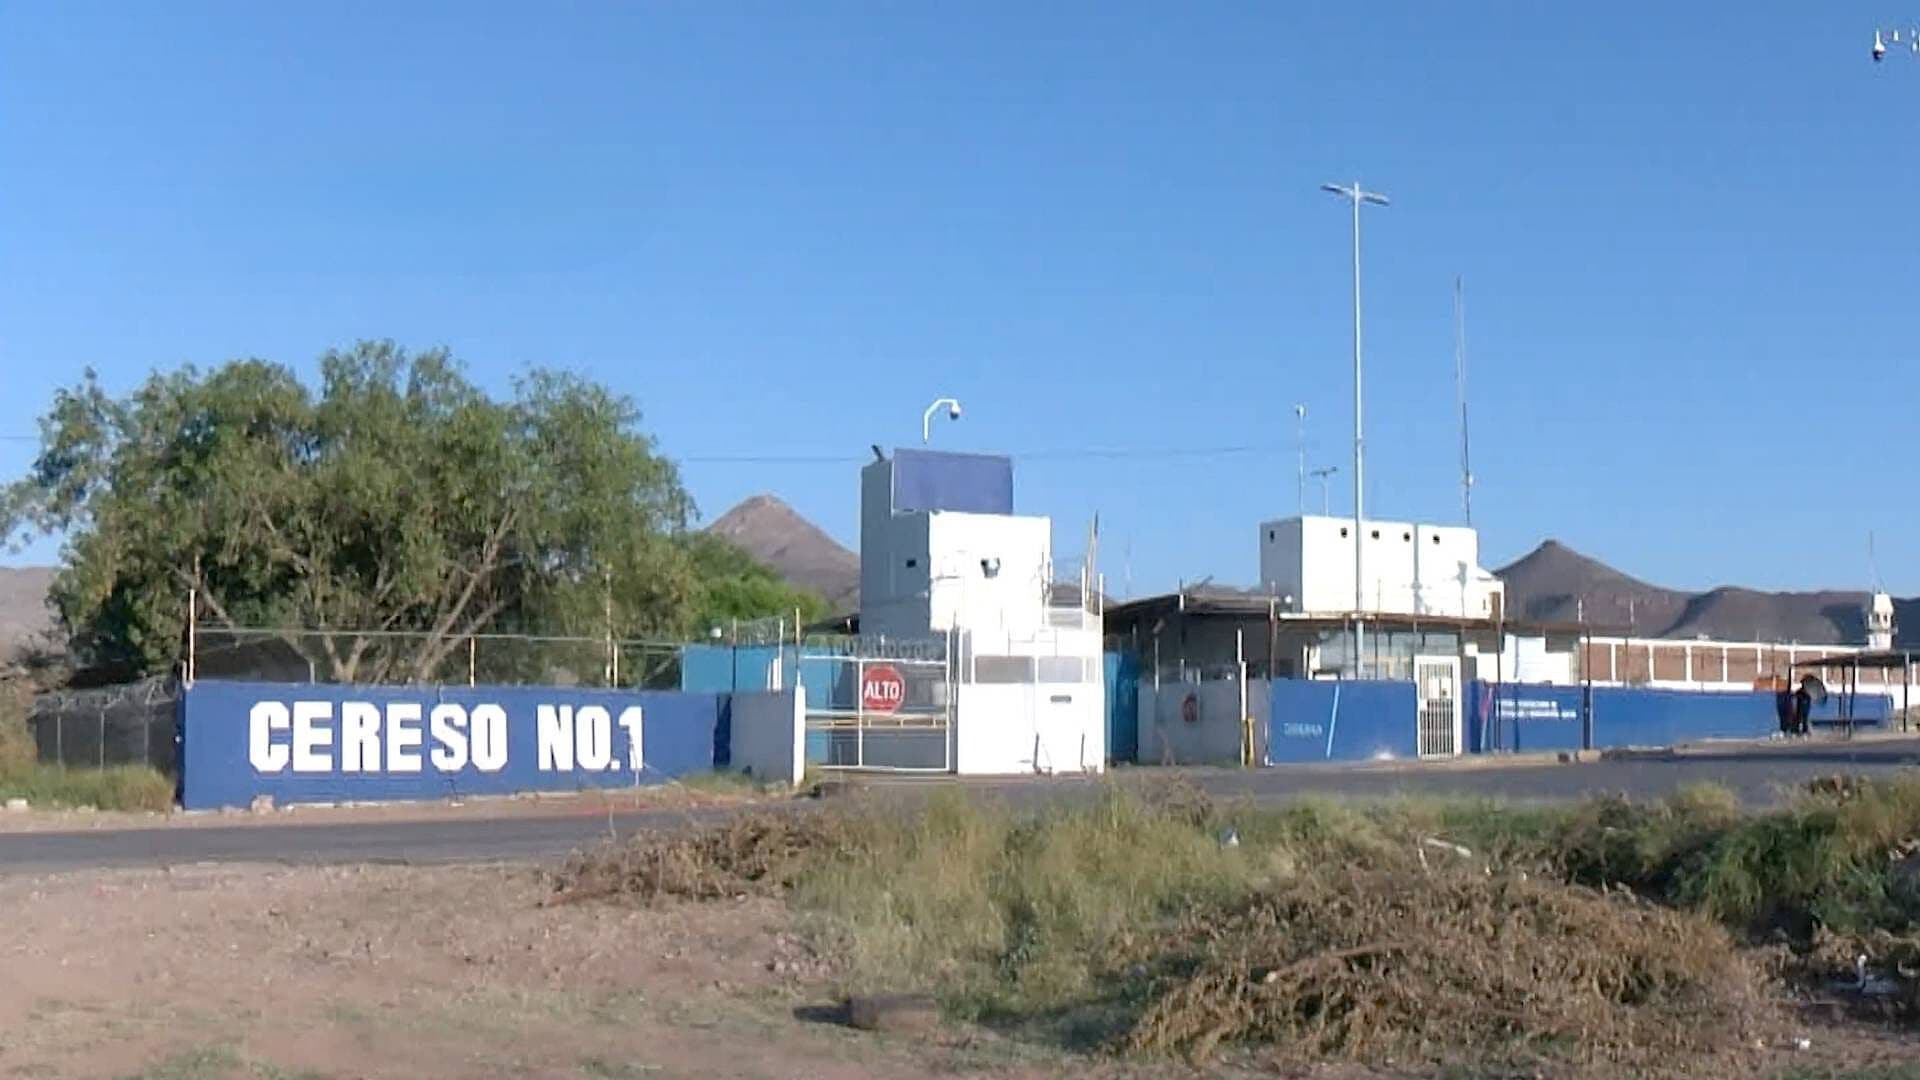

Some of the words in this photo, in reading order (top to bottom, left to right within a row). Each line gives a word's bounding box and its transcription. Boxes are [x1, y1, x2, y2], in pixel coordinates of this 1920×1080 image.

[864, 680, 900, 700] ALTO
[249, 701, 508, 772] CERESO
[537, 704, 643, 772] NO.1
